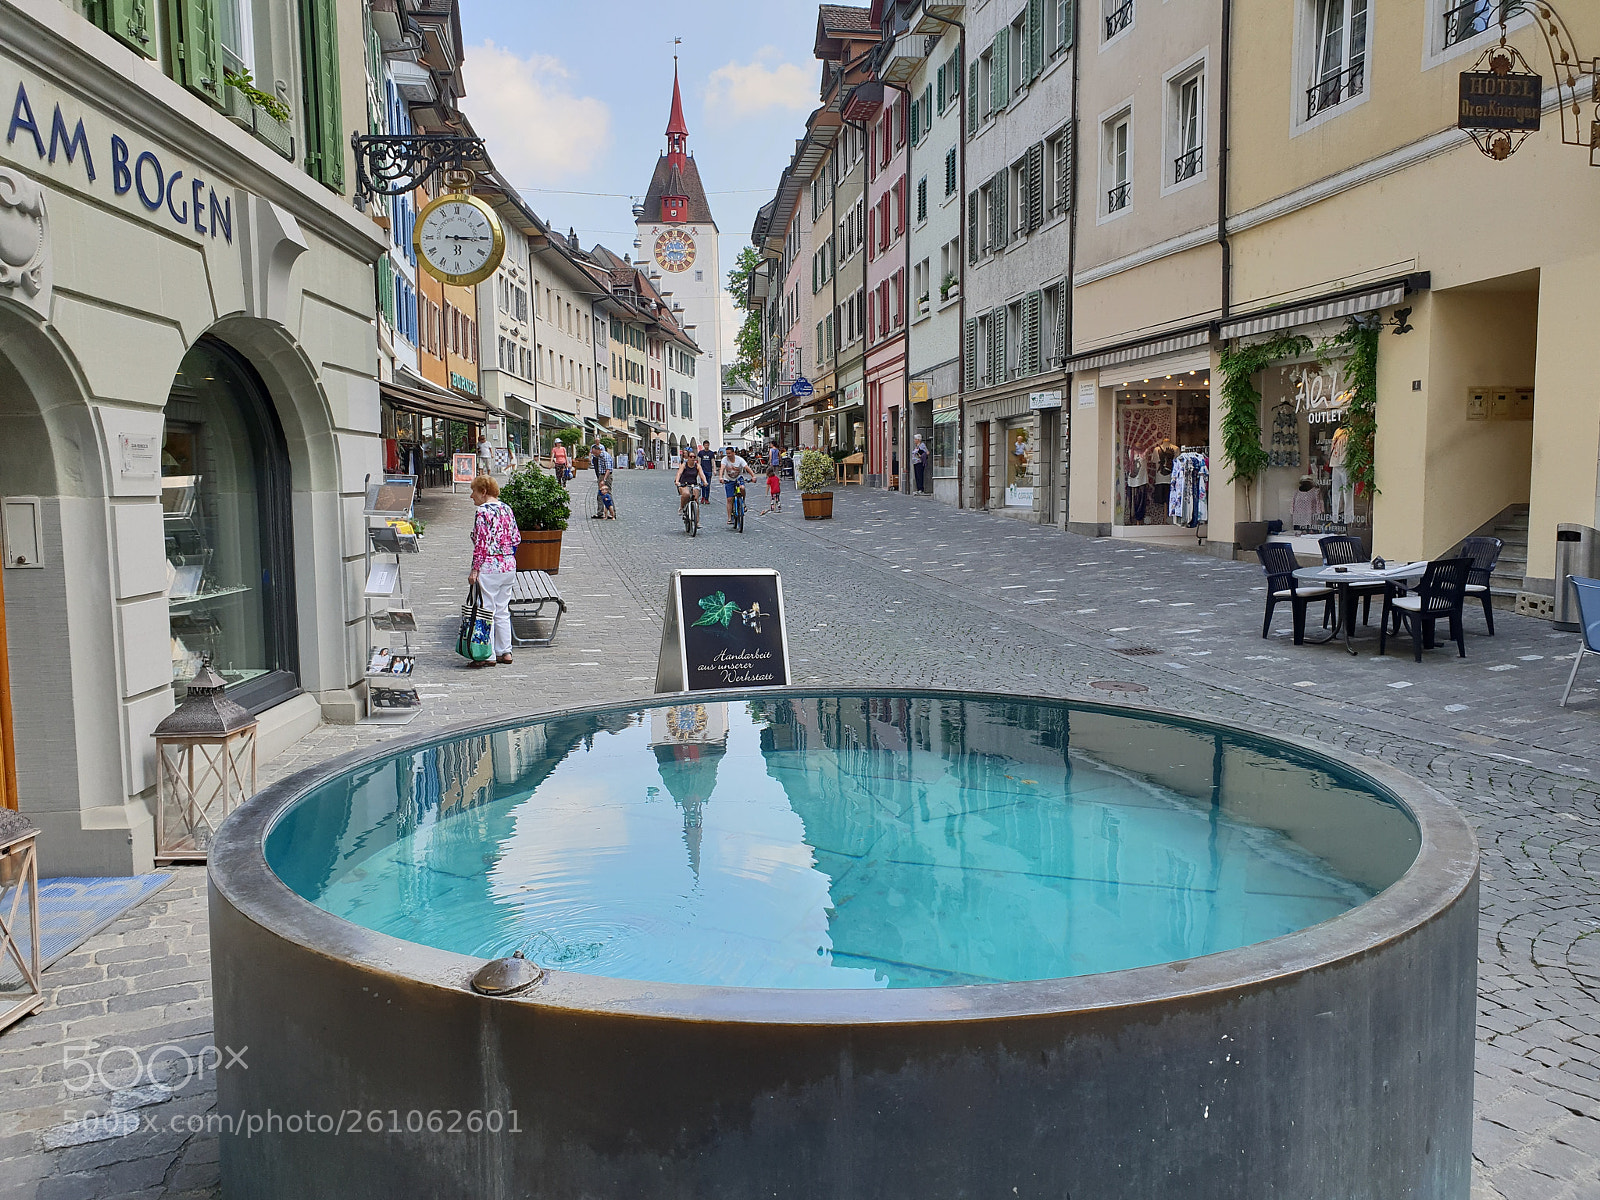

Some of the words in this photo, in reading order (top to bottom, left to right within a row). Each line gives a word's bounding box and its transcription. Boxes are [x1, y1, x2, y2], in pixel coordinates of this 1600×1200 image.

[1470, 77, 1534, 97] HOTEL
[1461, 99, 1488, 117] Drei
[8, 81, 96, 183] AM
[111, 133, 232, 245] BOGEN
[1308, 410, 1343, 424] OUTLET
[713, 648, 773, 662] Handarbeit
[697, 663, 717, 671] aus
[718, 662, 754, 670] unserer
[720, 669, 774, 683] Werkstatt
